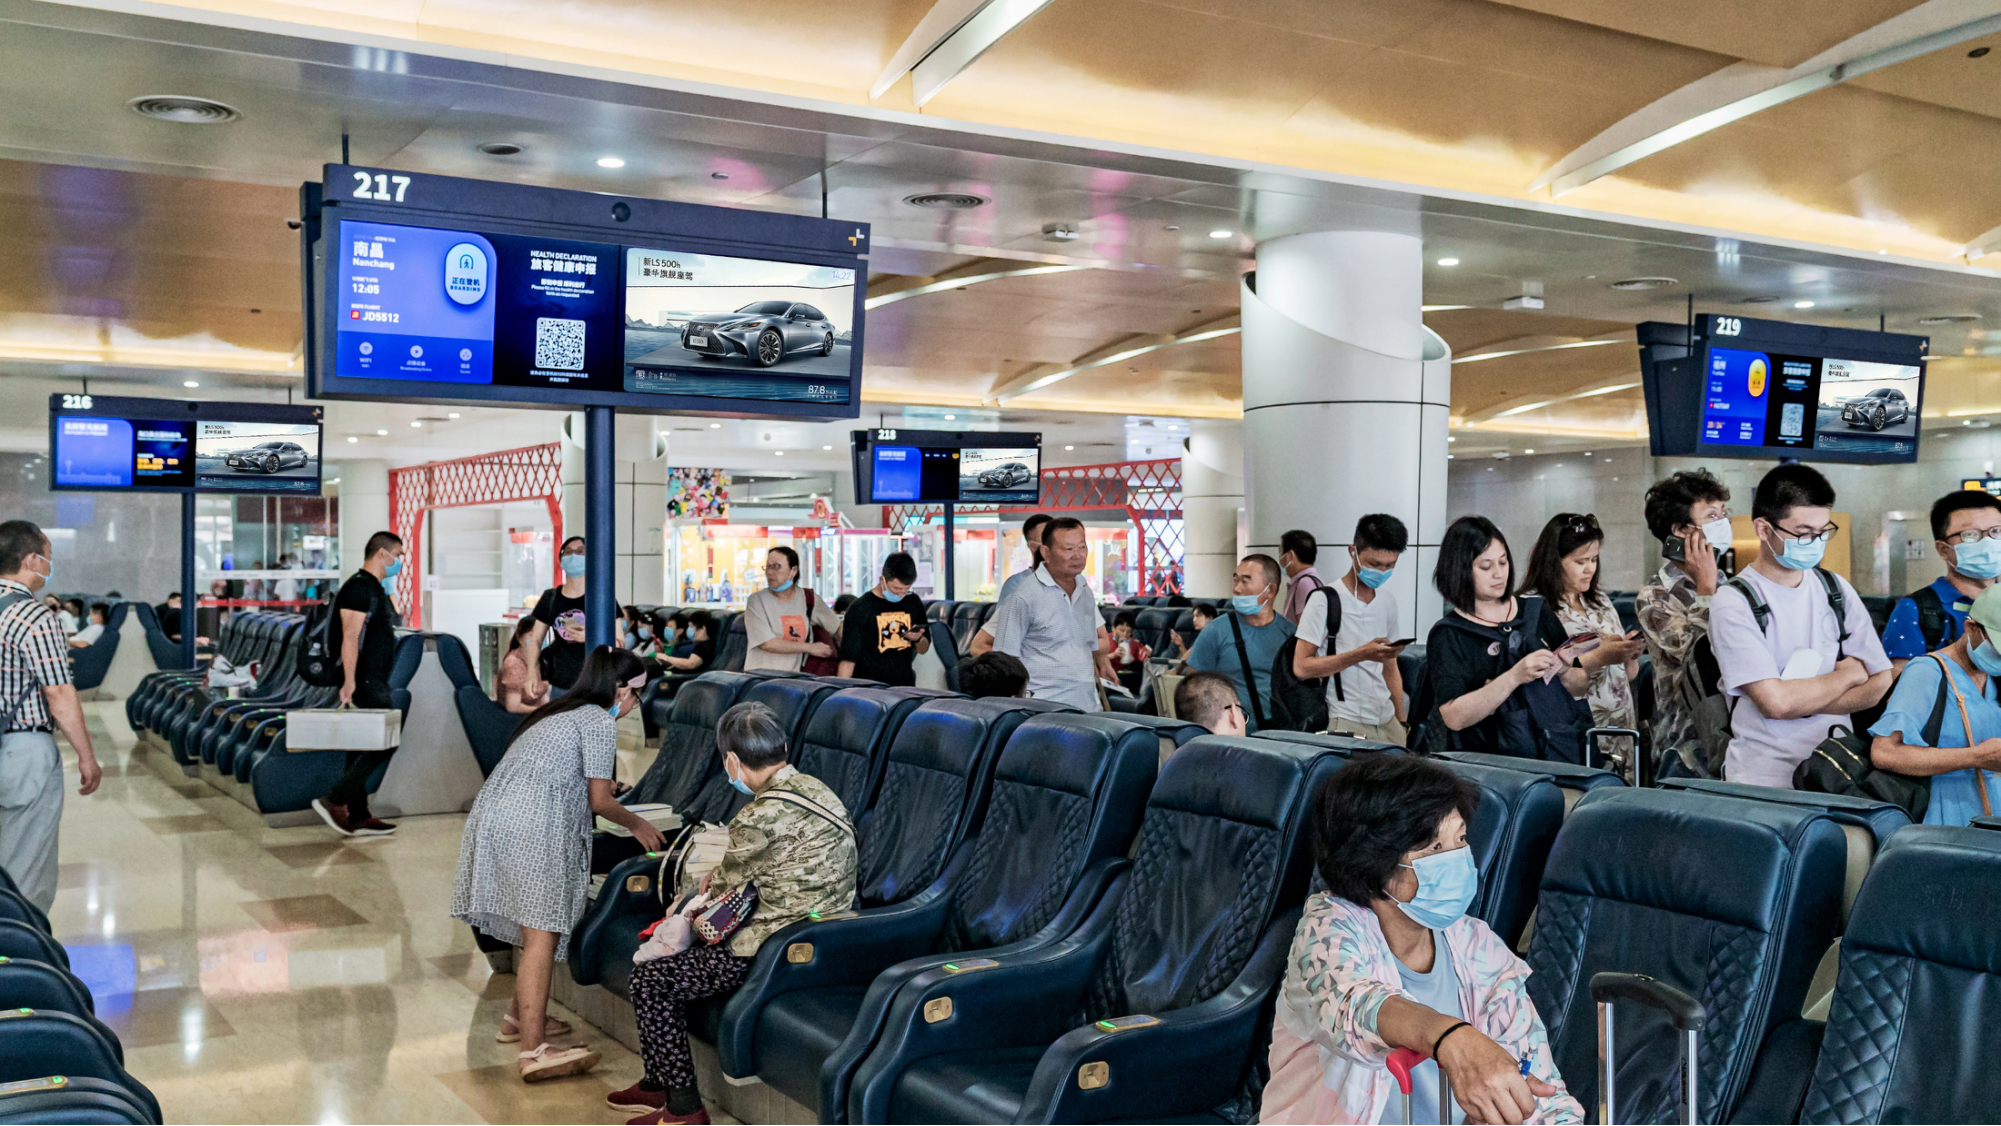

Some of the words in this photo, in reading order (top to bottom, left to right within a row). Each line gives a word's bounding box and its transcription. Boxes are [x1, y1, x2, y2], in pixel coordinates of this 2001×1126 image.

[353, 171, 411, 202] 217
[353, 241, 384, 259] 南昌
[530, 250, 555, 259] HEALTH
[555, 253, 597, 262] DECLARATION
[352, 257, 395, 271] Nanchang
[530, 258, 597, 275] 旅客健康申报
[643, 257, 661, 266] 新LS
[661, 260, 681, 269] 500h
[452, 276, 480, 286] 正在登机
[352, 283, 380, 295] 12:05
[362, 311, 400, 323] JD5512
[1716, 317, 1742, 336] 219
[808, 385, 826, 394] 87.8
[62, 394, 93, 409] 216
[878, 429, 896, 440] 218
